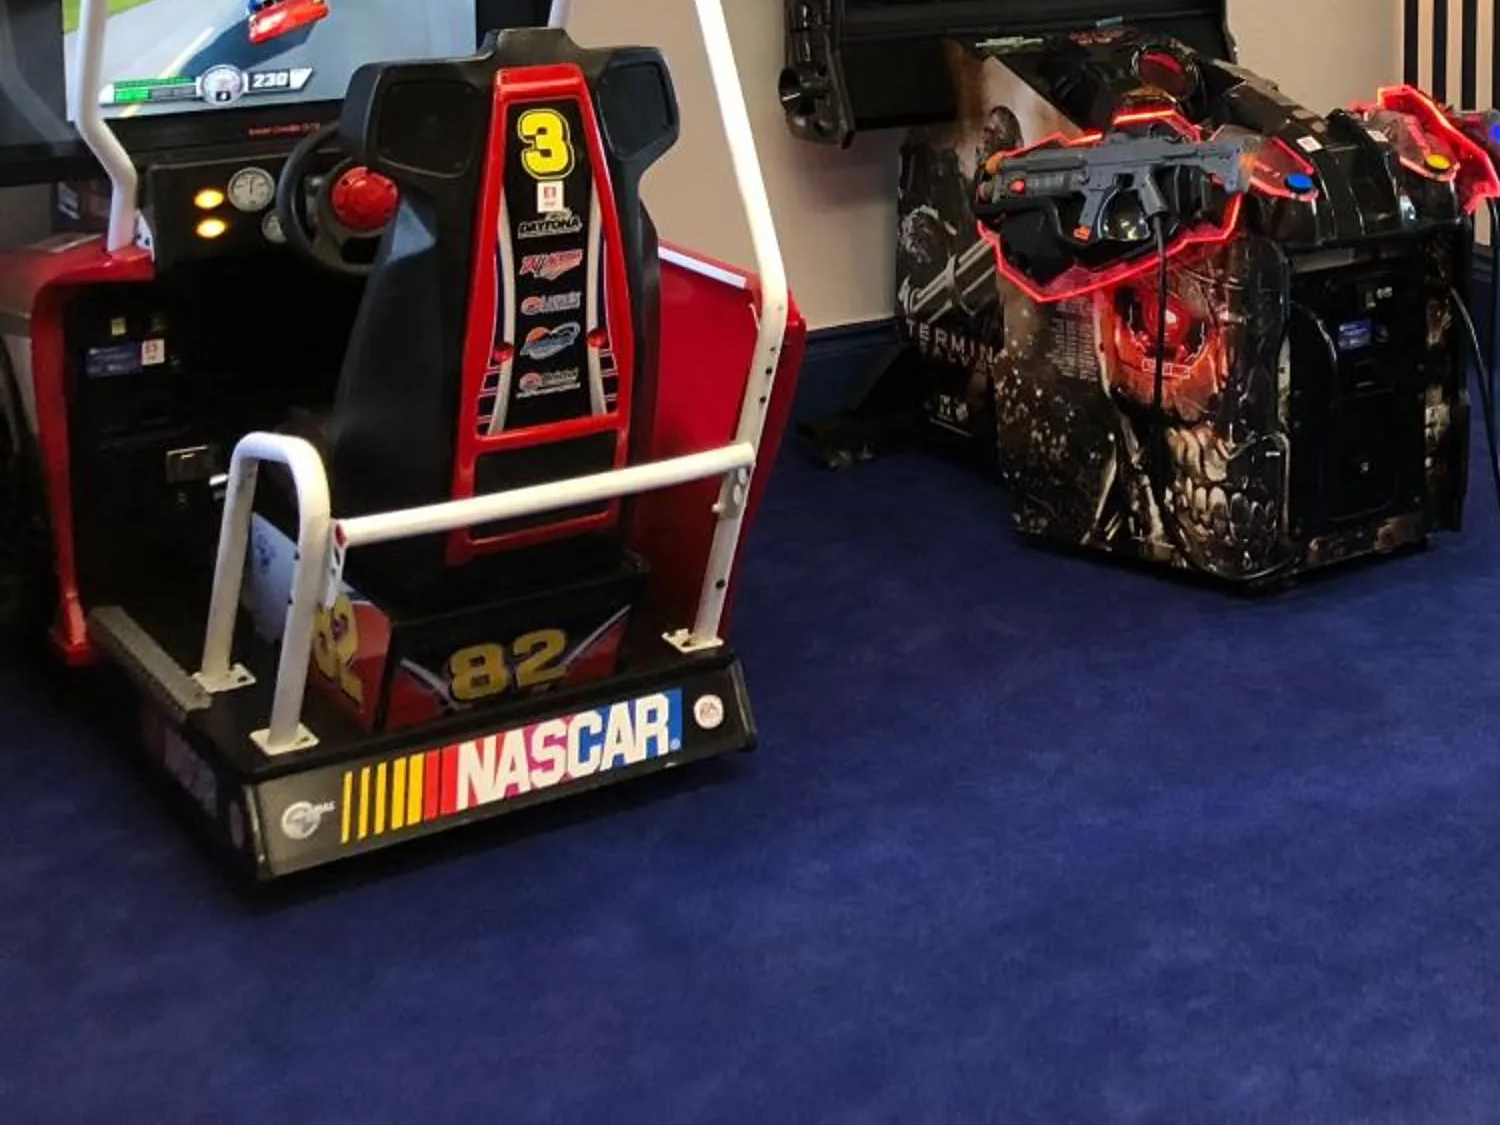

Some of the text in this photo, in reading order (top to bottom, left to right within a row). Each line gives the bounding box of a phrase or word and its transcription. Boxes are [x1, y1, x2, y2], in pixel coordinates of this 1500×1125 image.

[252, 72, 289, 89] 230
[519, 109, 573, 179] 3
[905, 318, 994, 364] TERMIN
[450, 629, 567, 701] 82
[456, 692, 669, 811] NASCAR
